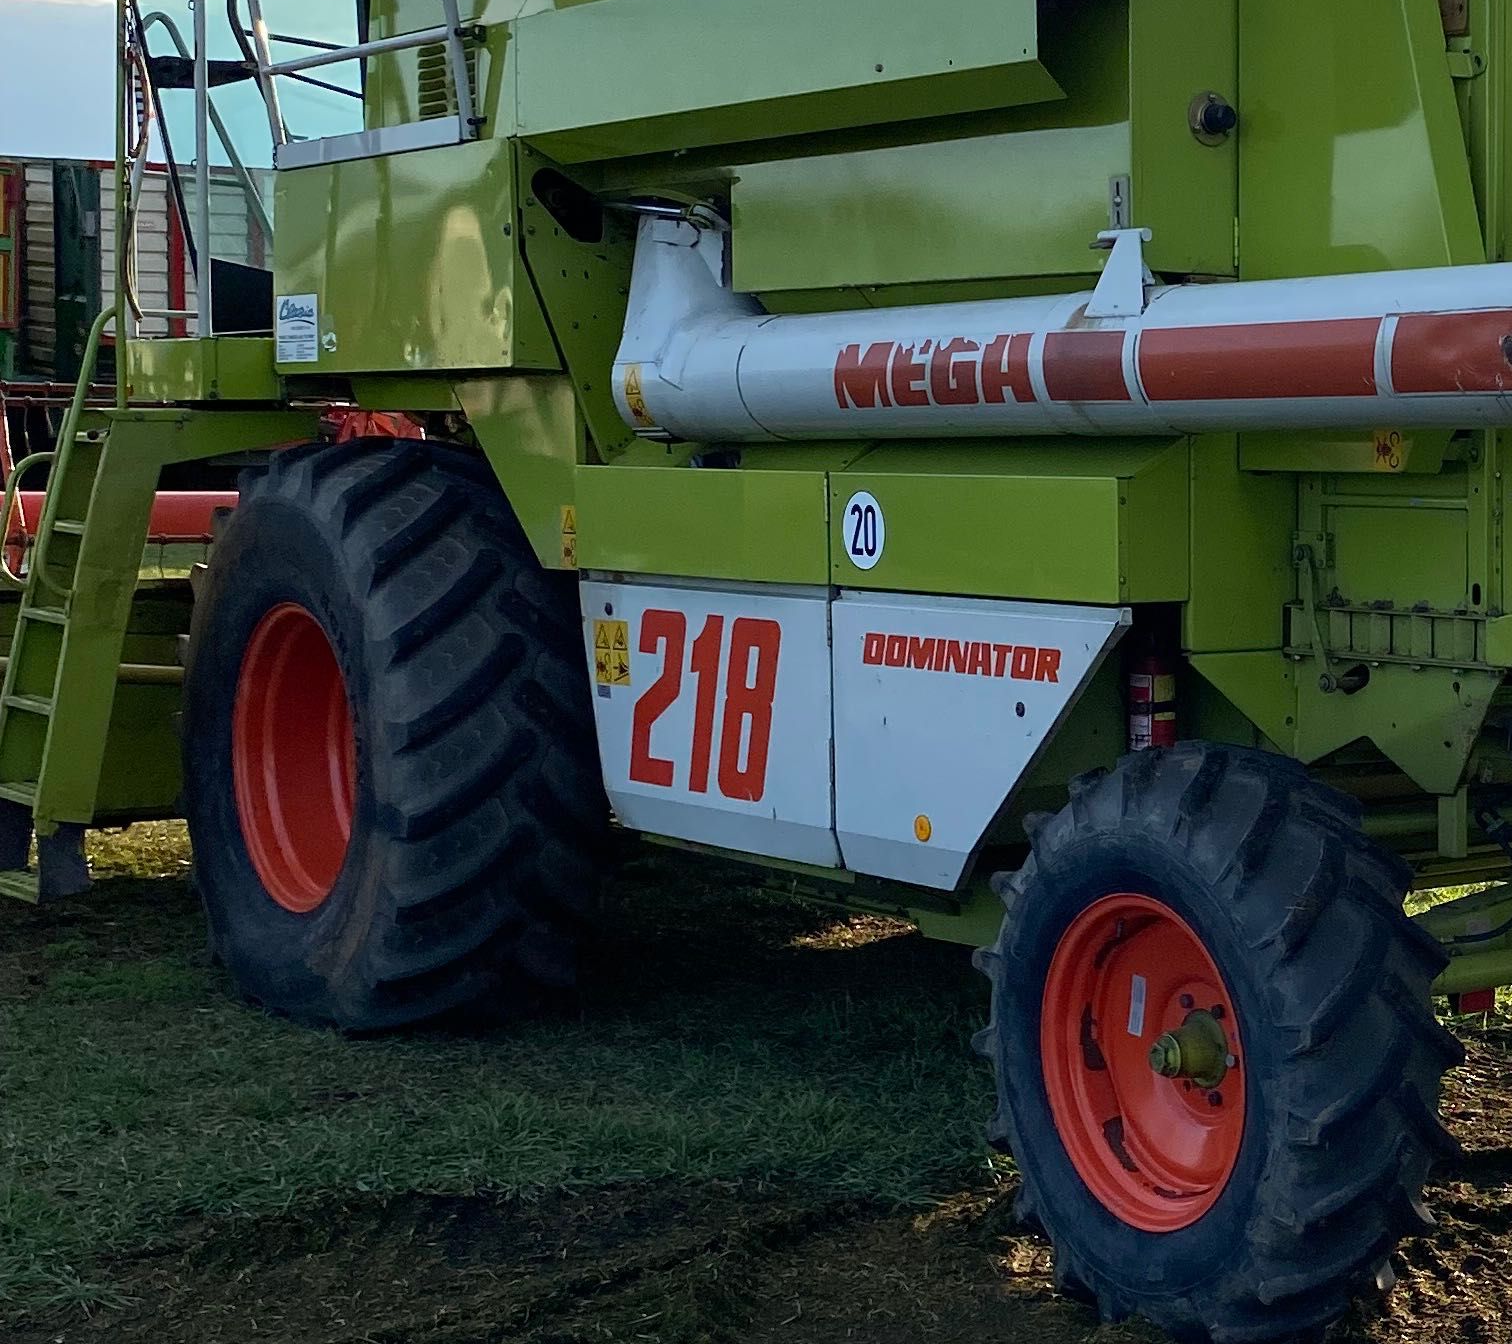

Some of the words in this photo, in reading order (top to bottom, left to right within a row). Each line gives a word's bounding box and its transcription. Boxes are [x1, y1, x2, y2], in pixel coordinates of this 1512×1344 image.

[834, 333, 1037, 409] MEGA
[850, 504, 878, 557] 20
[862, 632, 1061, 684] DOMINATOR
[629, 608, 782, 803] 218
